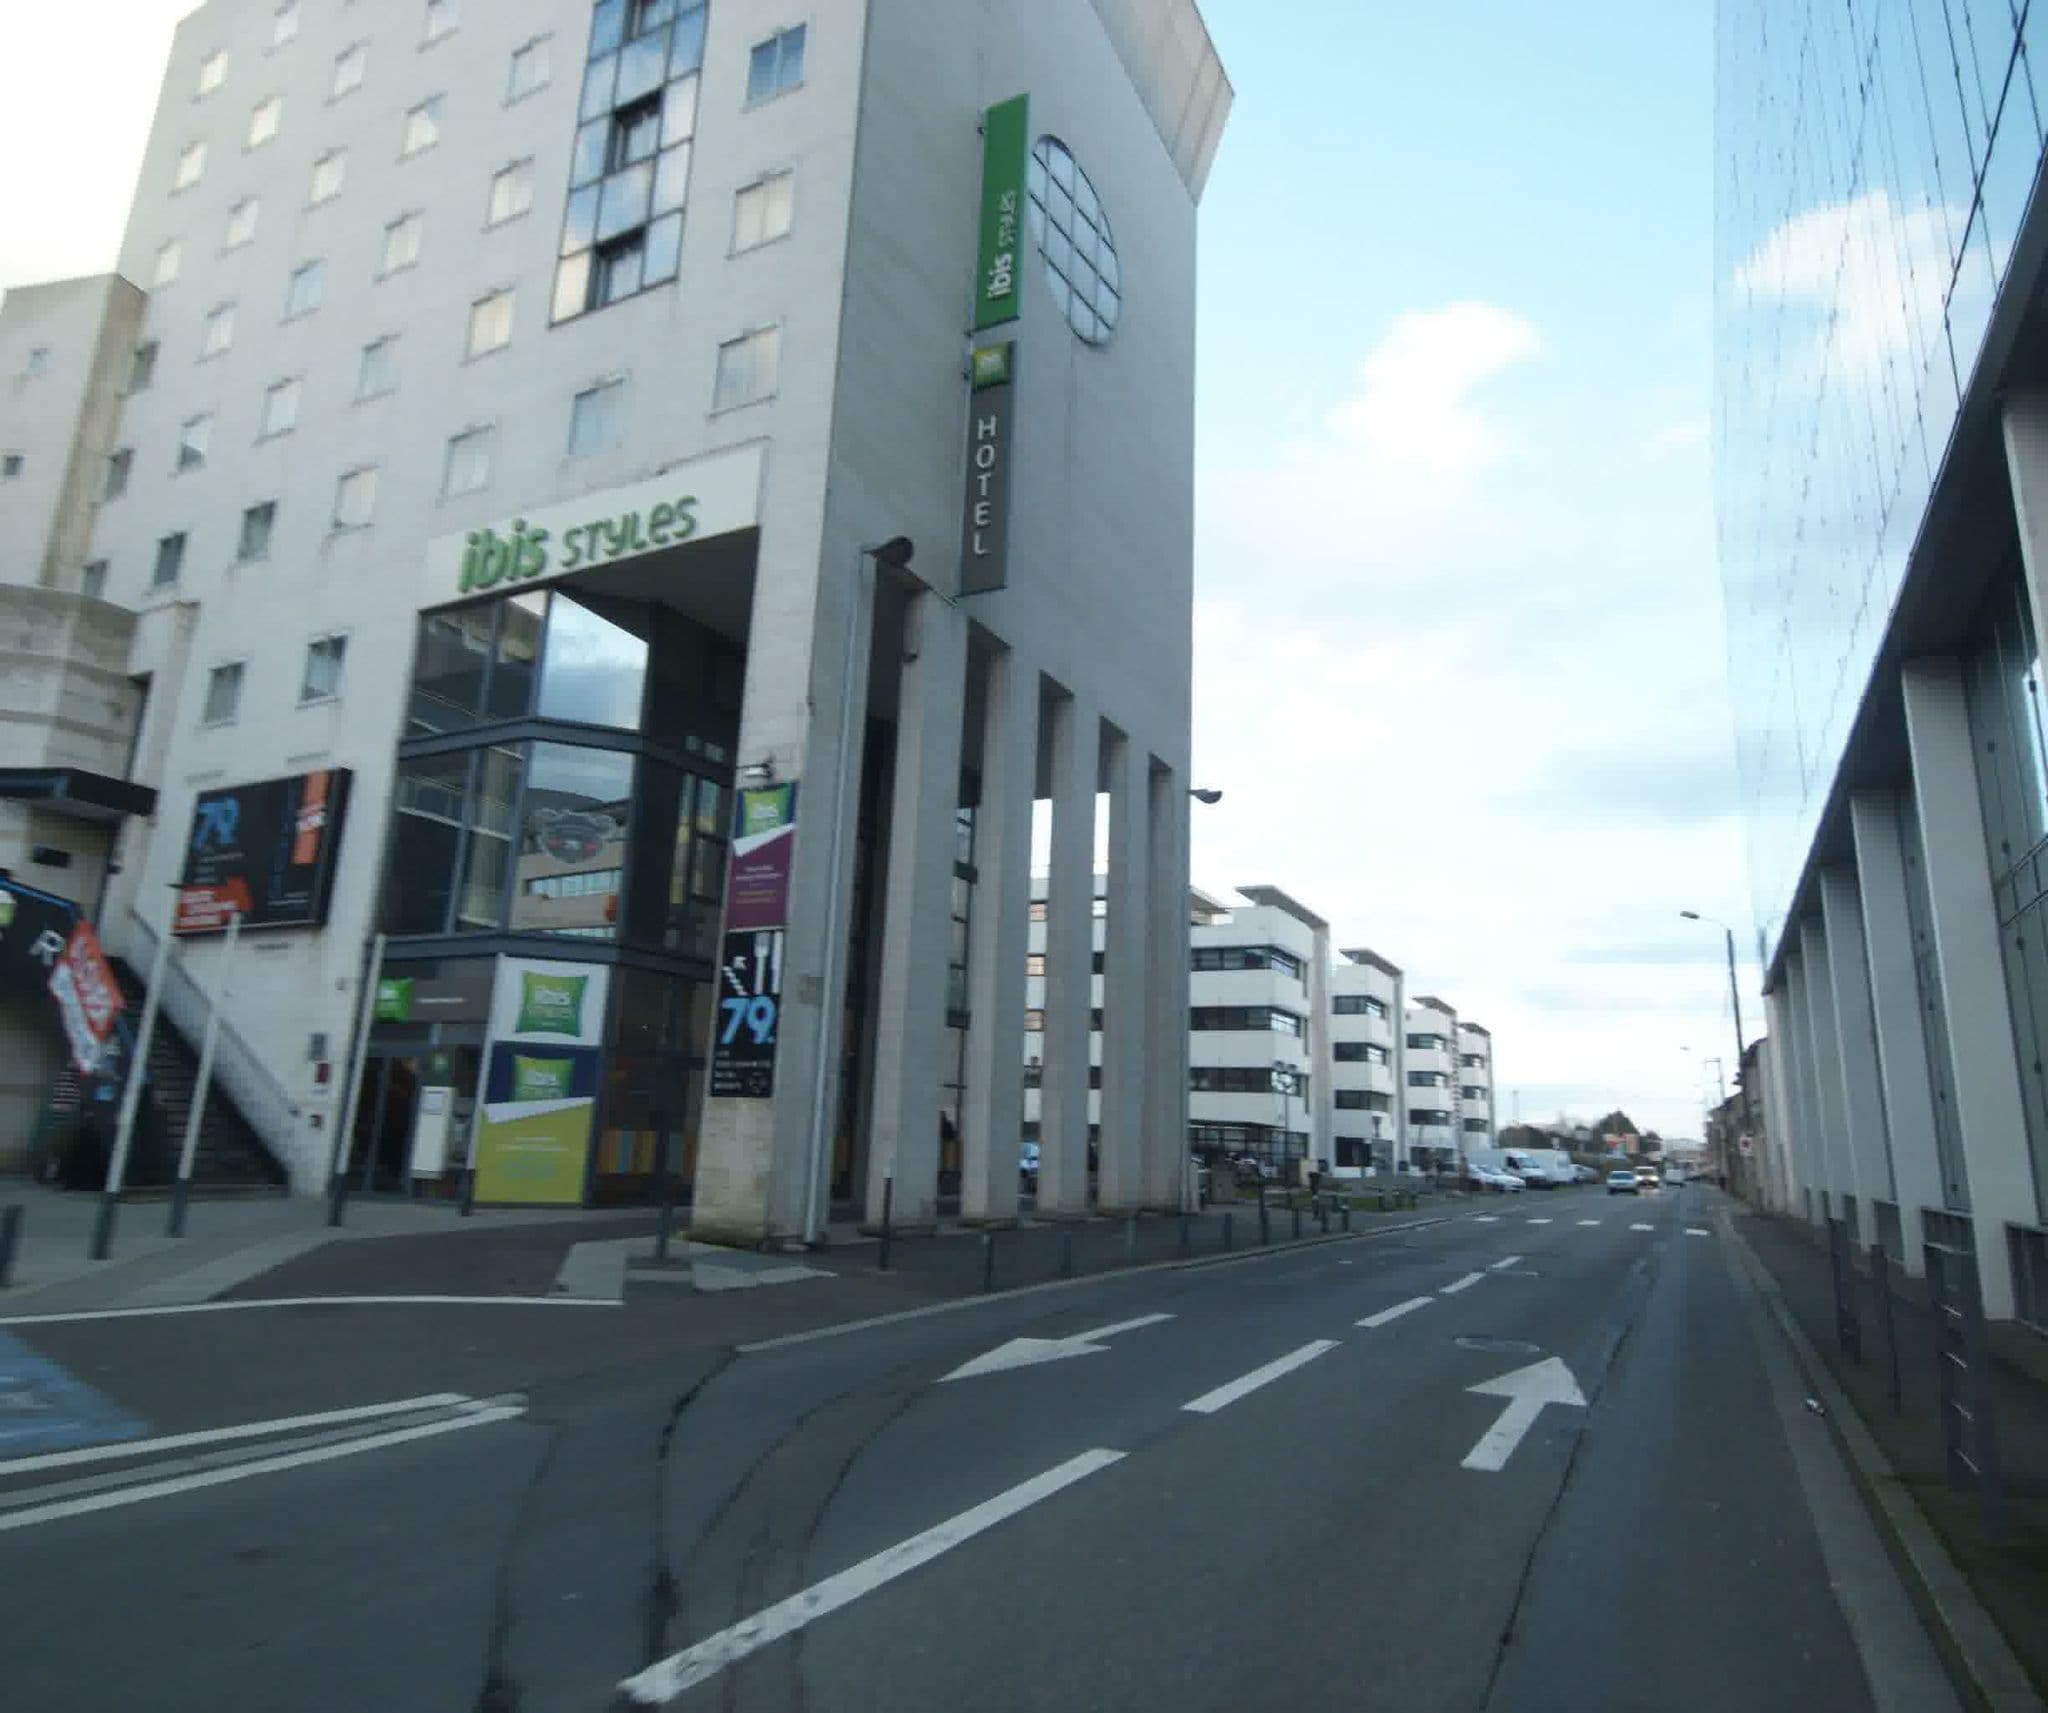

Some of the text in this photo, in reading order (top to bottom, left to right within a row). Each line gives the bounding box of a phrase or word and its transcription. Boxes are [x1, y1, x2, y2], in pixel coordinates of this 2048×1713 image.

[987, 252, 1014, 300] ibis
[974, 414, 998, 556] HOTEL
[457, 516, 549, 594] ibis
